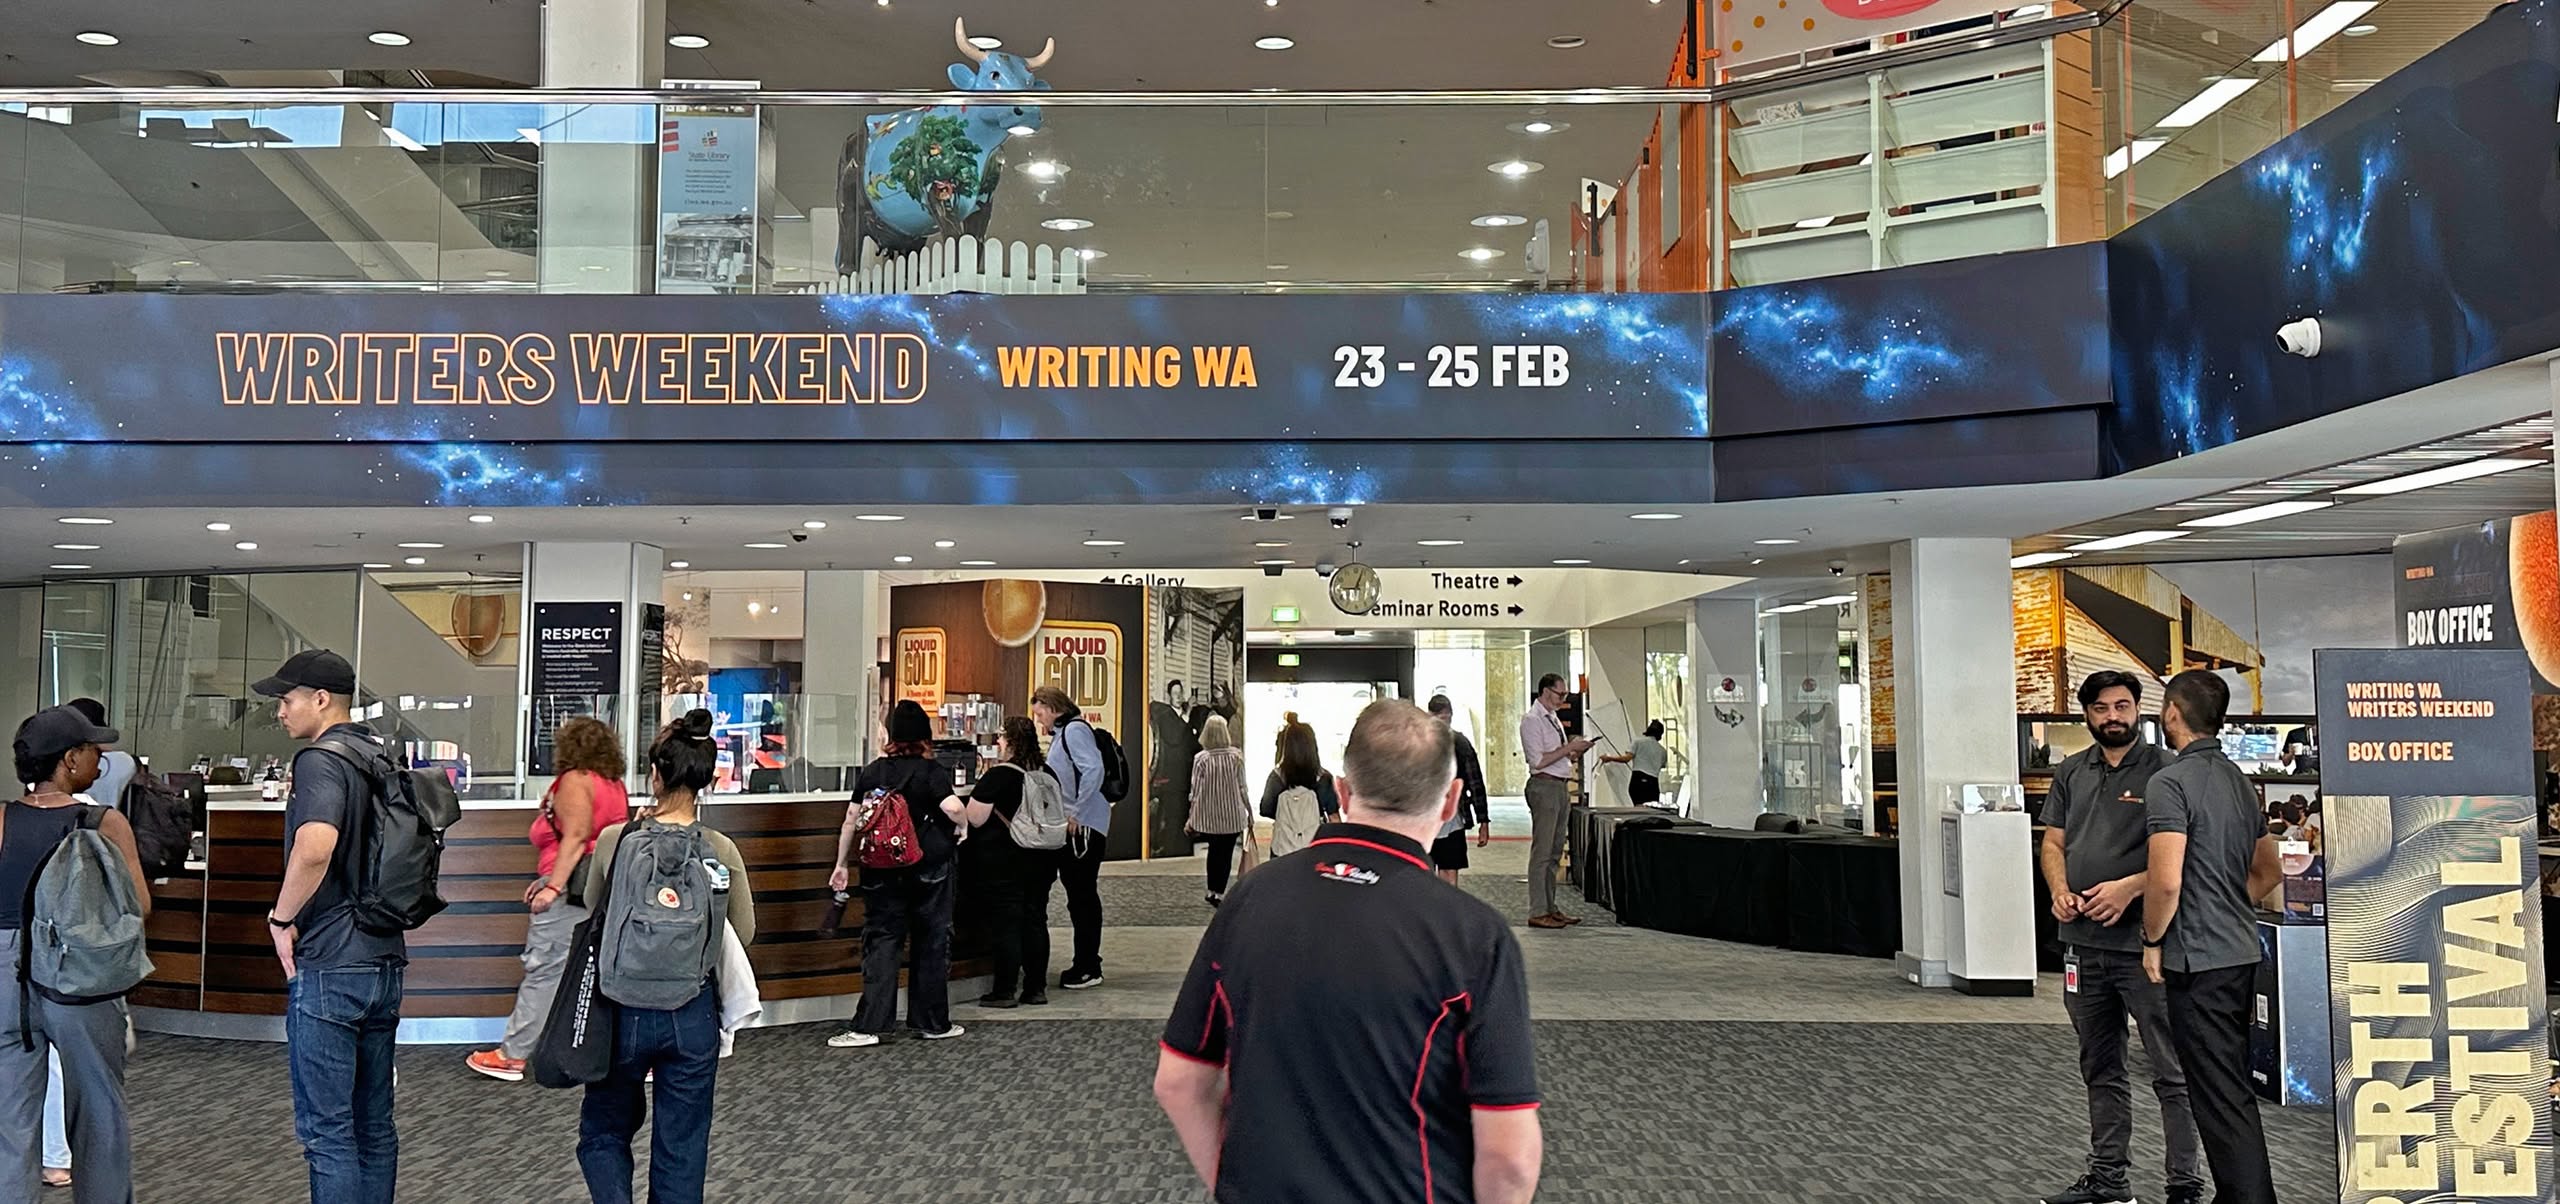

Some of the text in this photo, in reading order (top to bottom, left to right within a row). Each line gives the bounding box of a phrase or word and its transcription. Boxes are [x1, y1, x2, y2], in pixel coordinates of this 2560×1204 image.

[216, 333, 928, 405] WRITERS WEEKEND
[997, 346, 1258, 388] WRITING WA
[1334, 345, 1570, 387] 23 - 25 FEB
[1432, 572, 1499, 589] Theatre
[1371, 599, 1499, 616] eminar Rooms
[541, 628, 612, 640] RESPECT
[2407, 604, 2493, 646] BOX OFFICE
[905, 639, 937, 653] LIQUID
[1044, 637, 1106, 656] LIQUID
[904, 652, 937, 686] GOLD
[1044, 656, 1108, 706] GOLD
[2346, 682, 2442, 699] WRITING WA
[1088, 712, 1103, 723] WA
[2347, 701, 2495, 717] WRITERS WEEKEND
[2348, 742, 2454, 761] BOX OFFICE
[2441, 836, 2538, 1204] ESTIVAL
[2348, 962, 2439, 1204] ERTH
